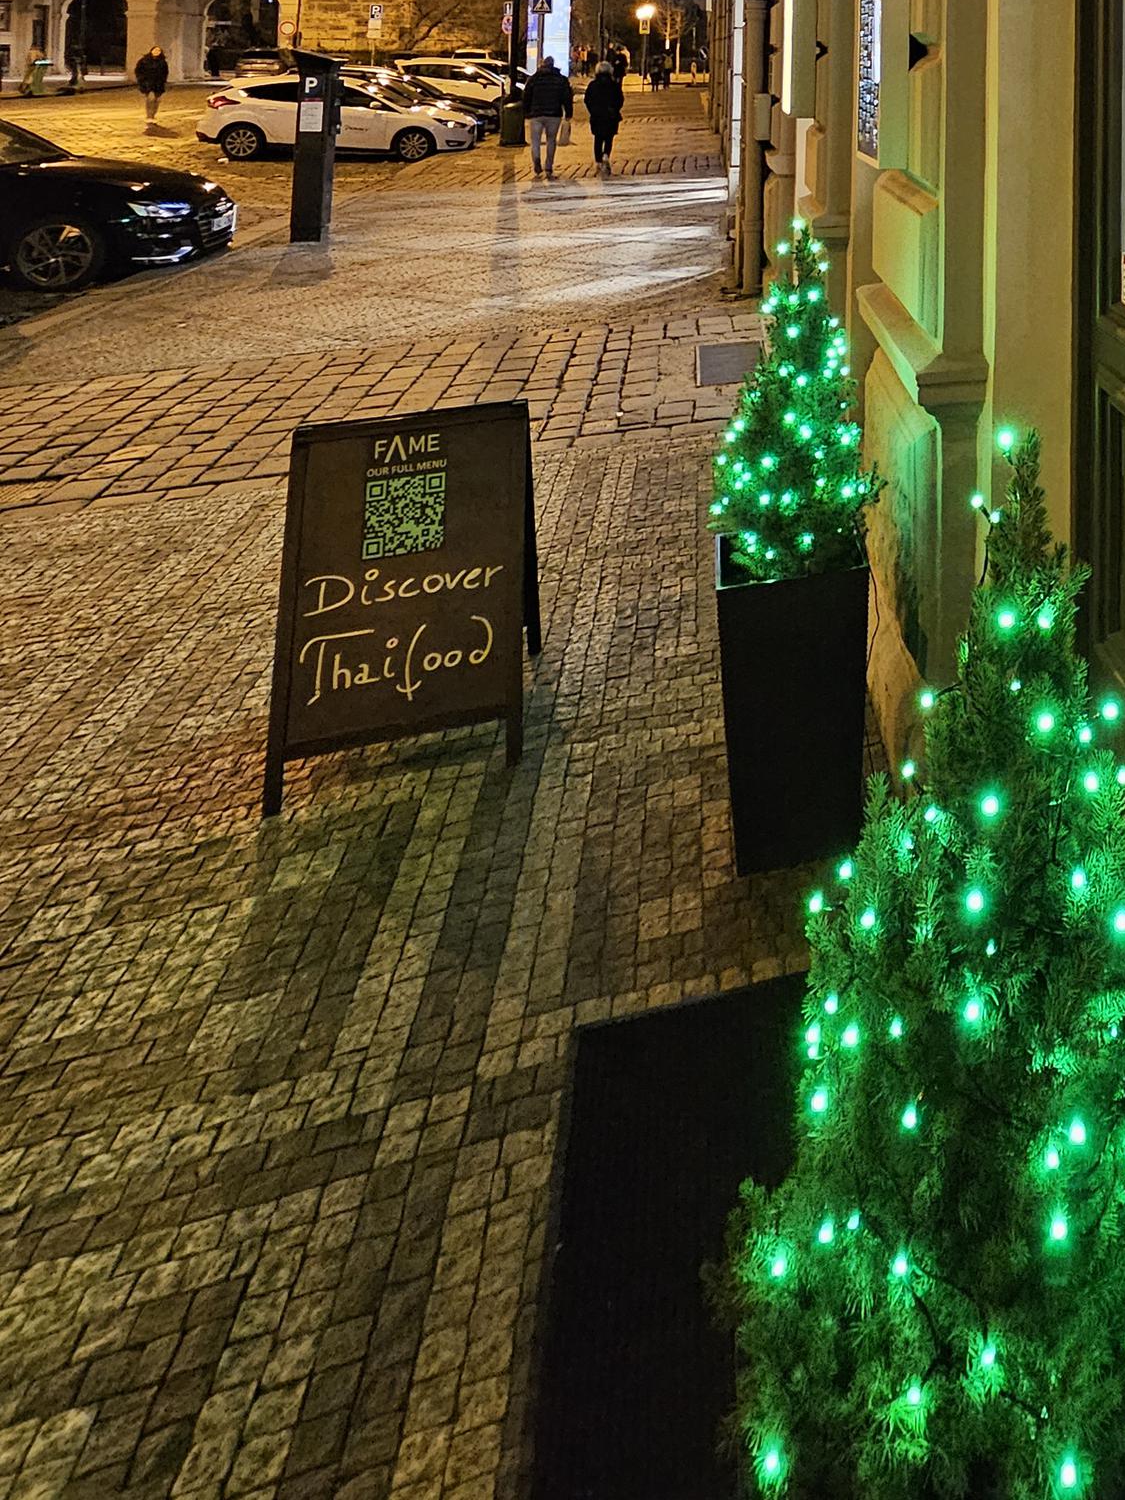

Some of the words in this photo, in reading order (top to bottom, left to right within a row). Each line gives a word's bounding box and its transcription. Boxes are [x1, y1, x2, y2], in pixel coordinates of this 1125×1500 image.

[304, 76, 318, 94] P
[374, 433, 440, 464] FAME
[366, 466, 389, 478] OUR
[391, 462, 414, 475] FULL
[416, 458, 447, 471] MENU
[303, 565, 504, 617] Discover
